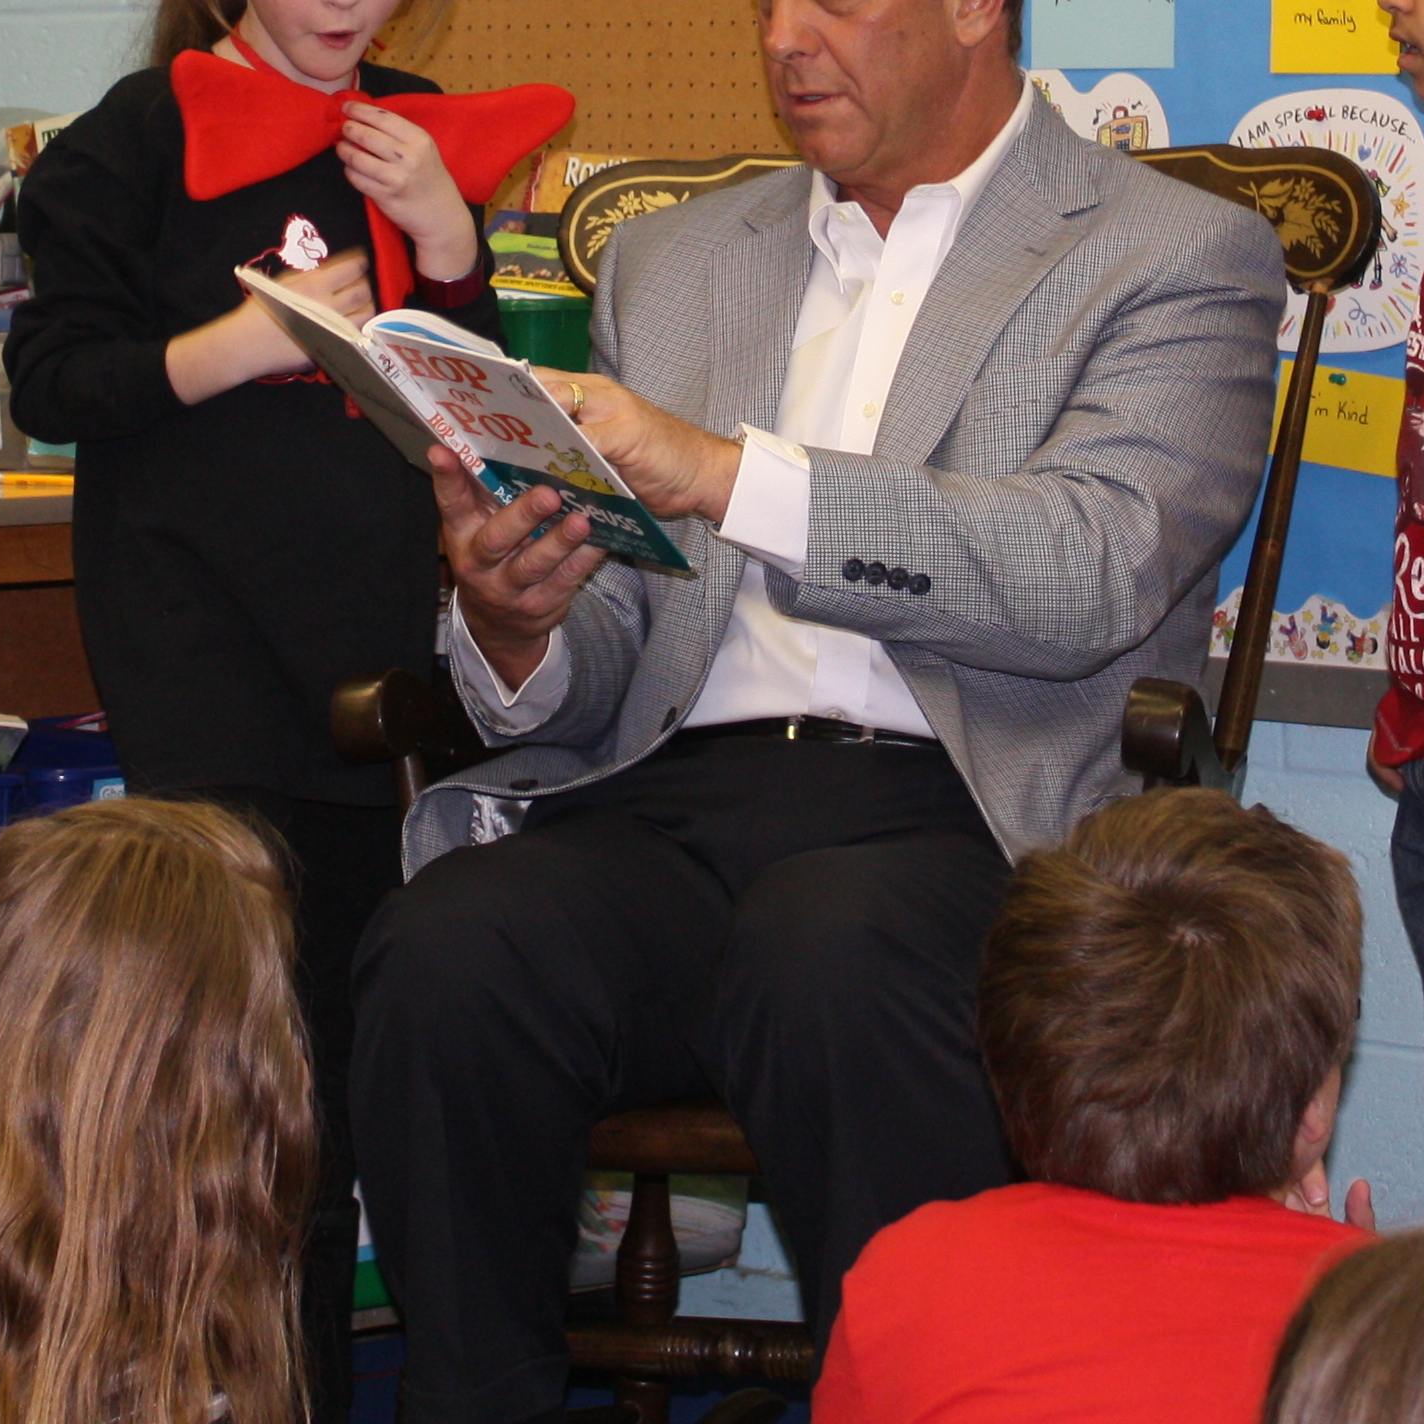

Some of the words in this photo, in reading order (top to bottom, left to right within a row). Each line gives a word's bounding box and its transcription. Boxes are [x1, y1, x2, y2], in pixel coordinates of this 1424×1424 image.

[1317, 11, 1356, 32] family
[1248, 121, 1270, 143] AM
[387, 343, 493, 393] HOP
[449, 388, 483, 406] ON
[428, 413, 455, 438] HOP
[458, 443, 482, 469] POP
[436, 401, 539, 448] POP
